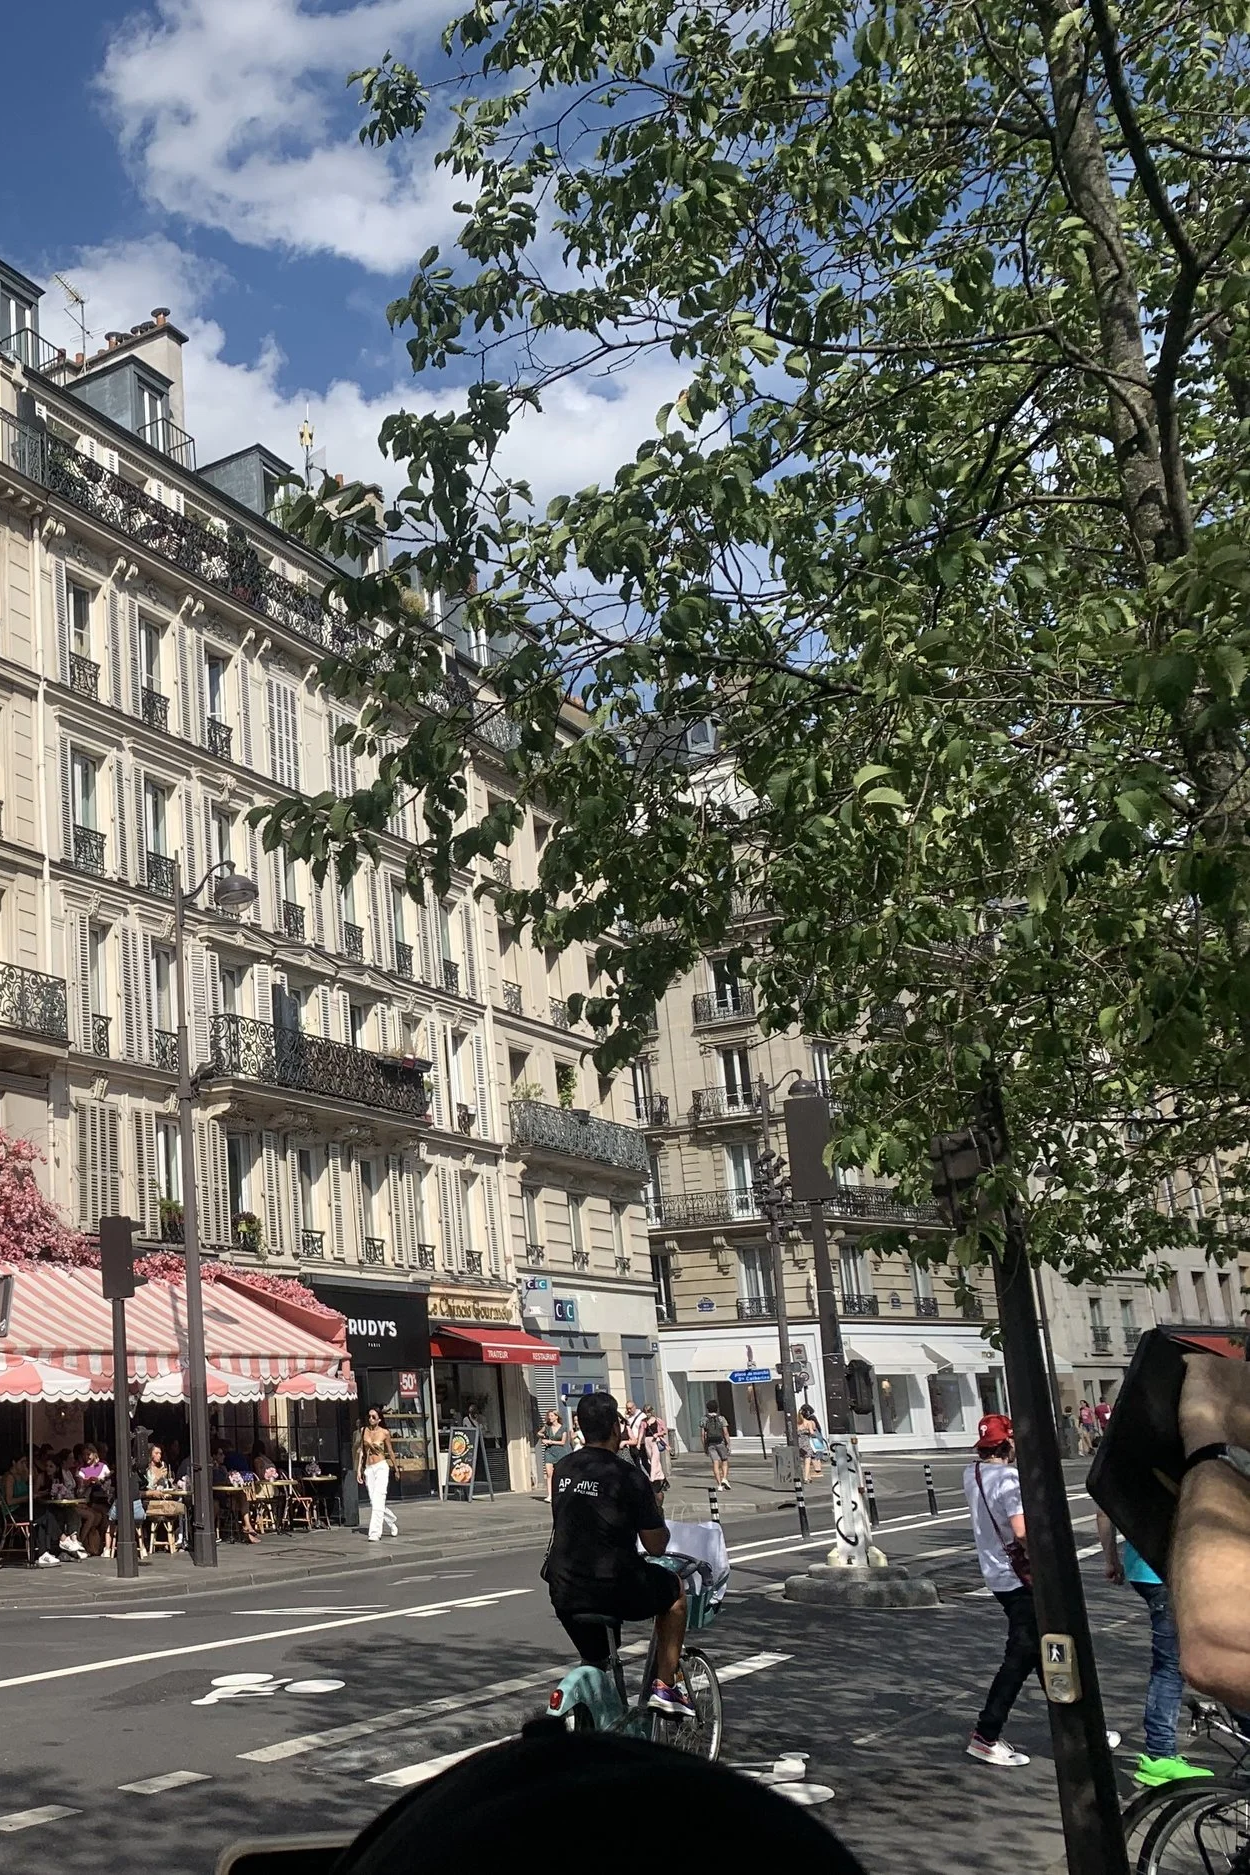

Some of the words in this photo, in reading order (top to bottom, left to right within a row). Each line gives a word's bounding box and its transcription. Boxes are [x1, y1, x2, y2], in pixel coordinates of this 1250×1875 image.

[348, 1318, 398, 1338] RUDY'S
[487, 1349, 509, 1359] TRAITEUR
[532, 1352, 557, 1361] RESTAURANT
